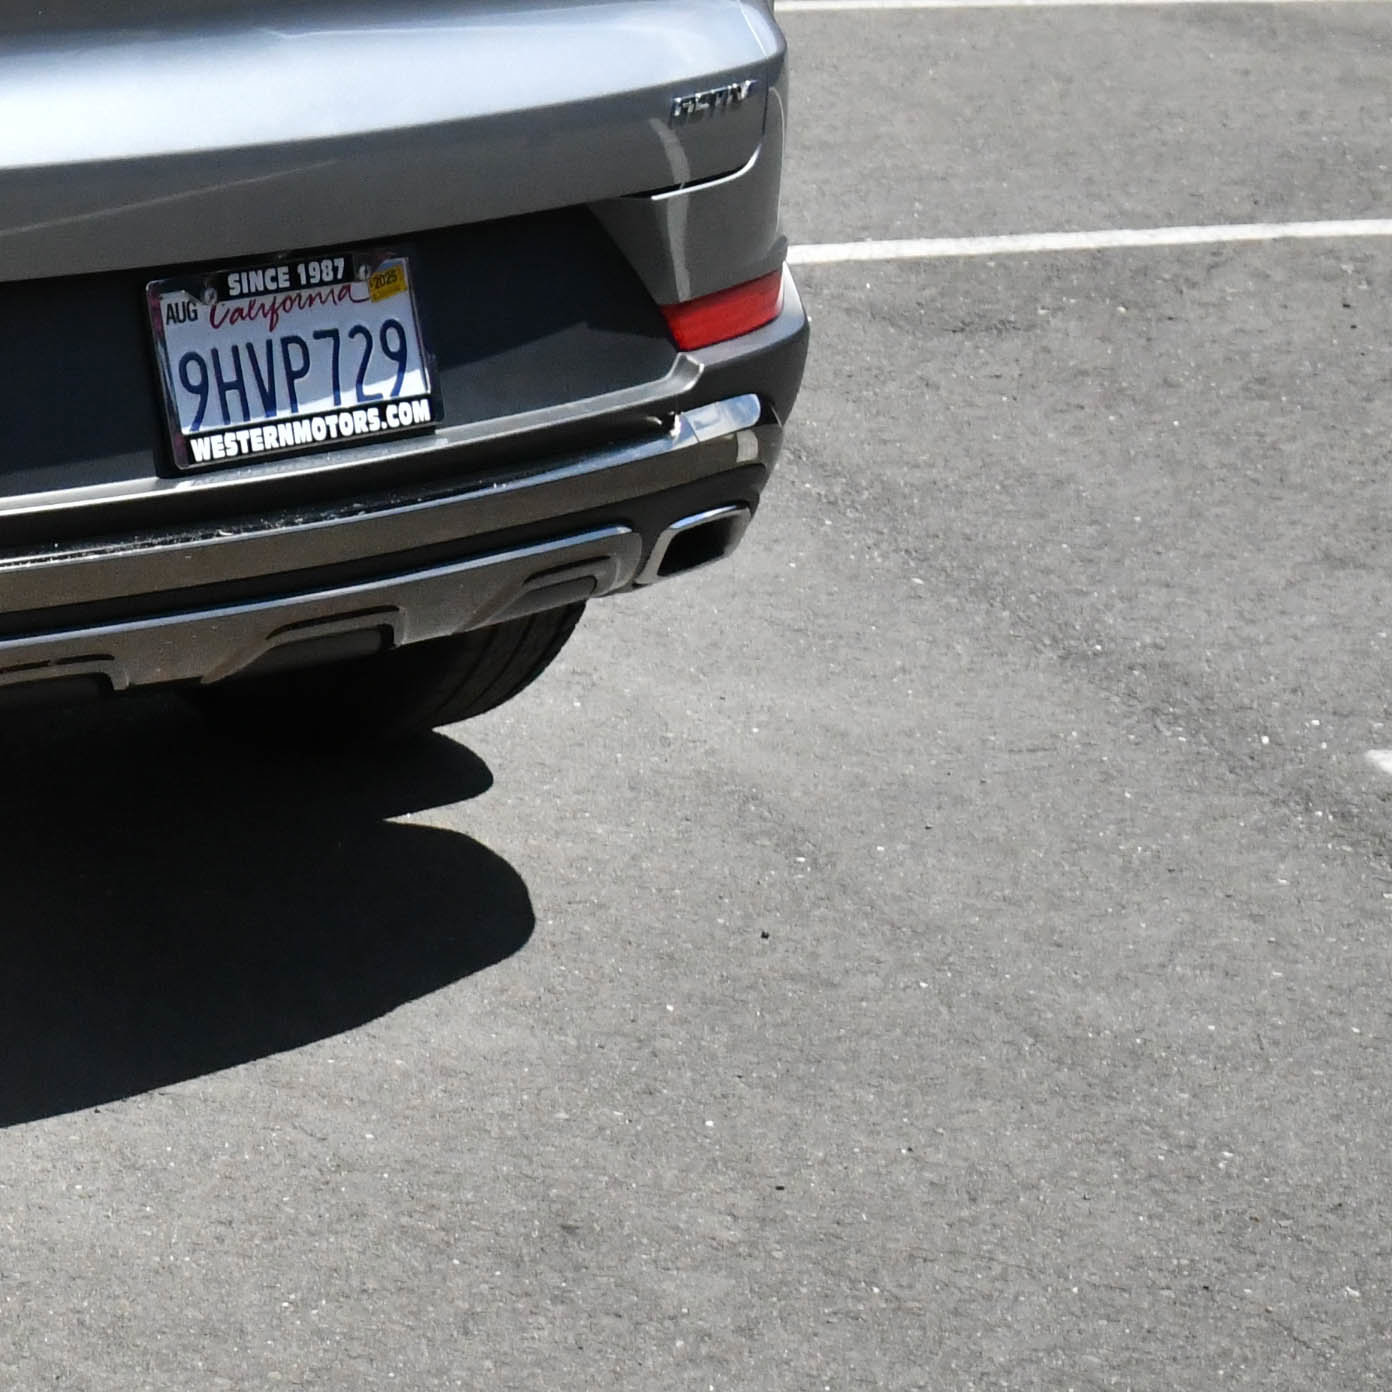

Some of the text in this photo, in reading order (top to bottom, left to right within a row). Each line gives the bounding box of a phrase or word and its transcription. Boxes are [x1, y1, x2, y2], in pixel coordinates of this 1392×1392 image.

[227, 258, 345, 296] SINCE 1987
[166, 301, 199, 326] AUG
[209, 284, 370, 332] California
[178, 318, 409, 432] 9HVP729
[190, 399, 432, 462] WESTERNMOTORS.COM
